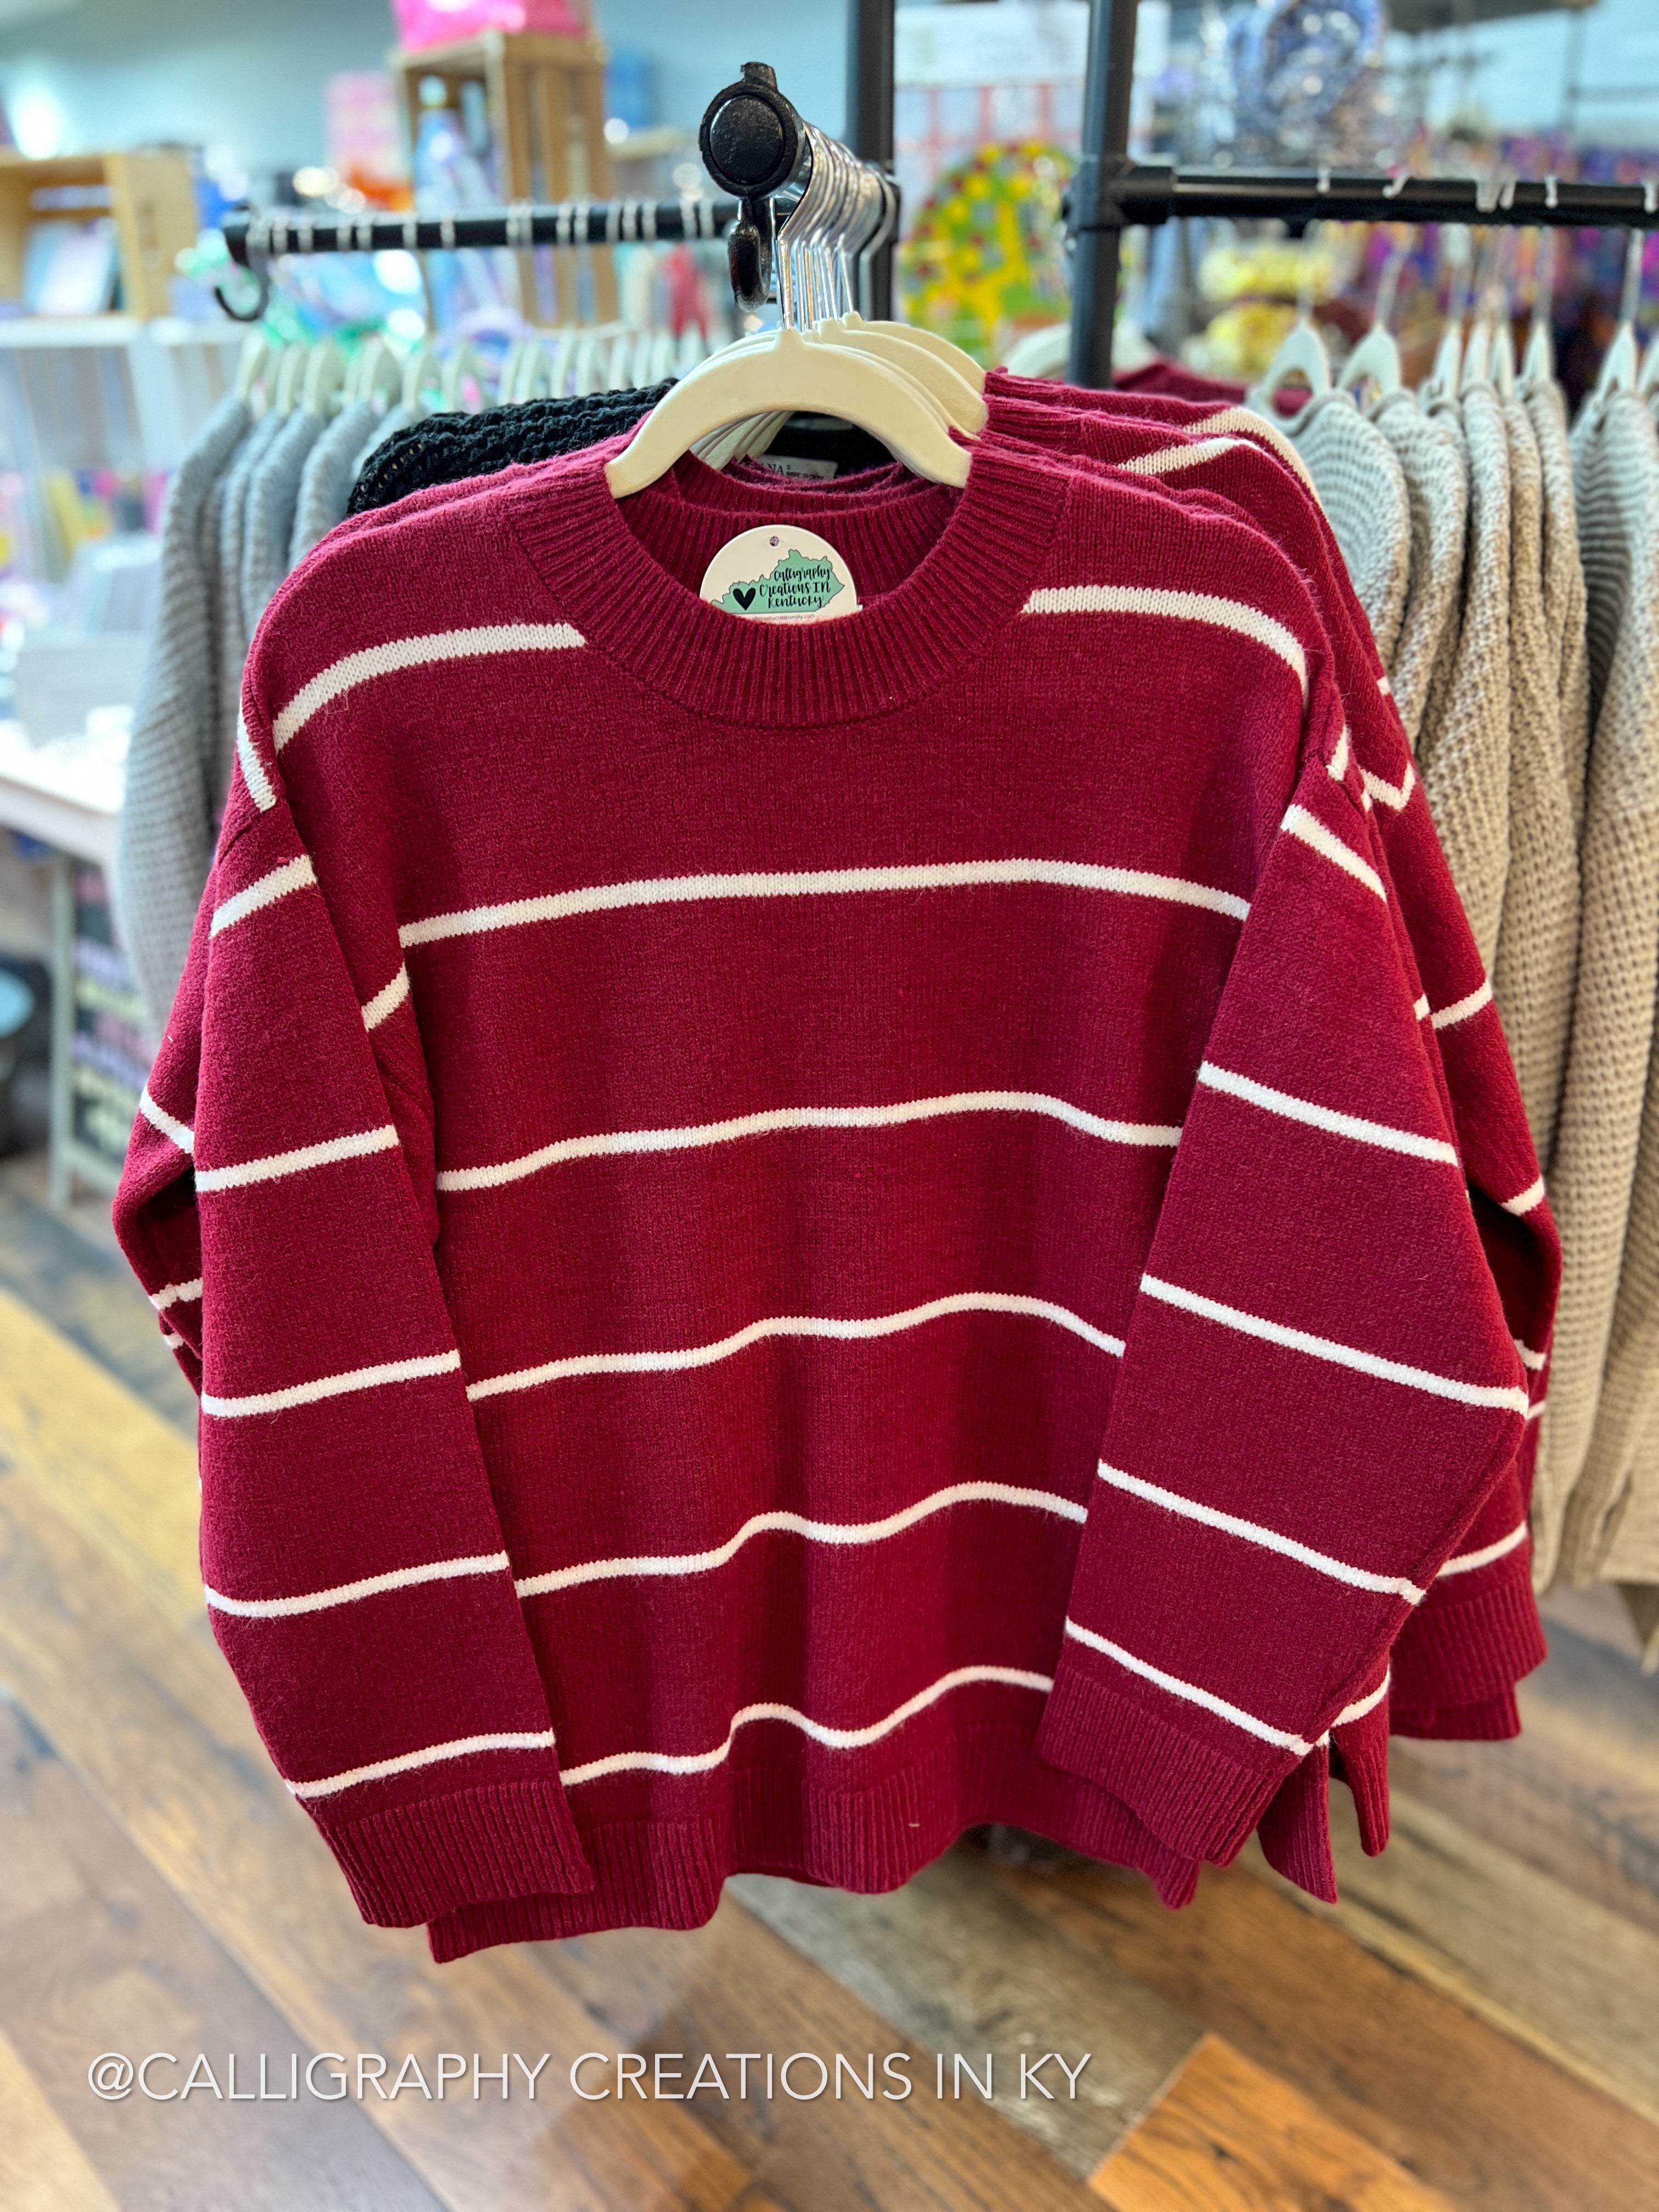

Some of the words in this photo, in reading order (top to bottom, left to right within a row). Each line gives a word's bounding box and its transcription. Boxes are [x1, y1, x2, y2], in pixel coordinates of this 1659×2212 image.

[774, 565, 830, 582] Calligraphy
[759, 582, 811, 597] Creations
[768, 595, 824, 608] Kentucky
